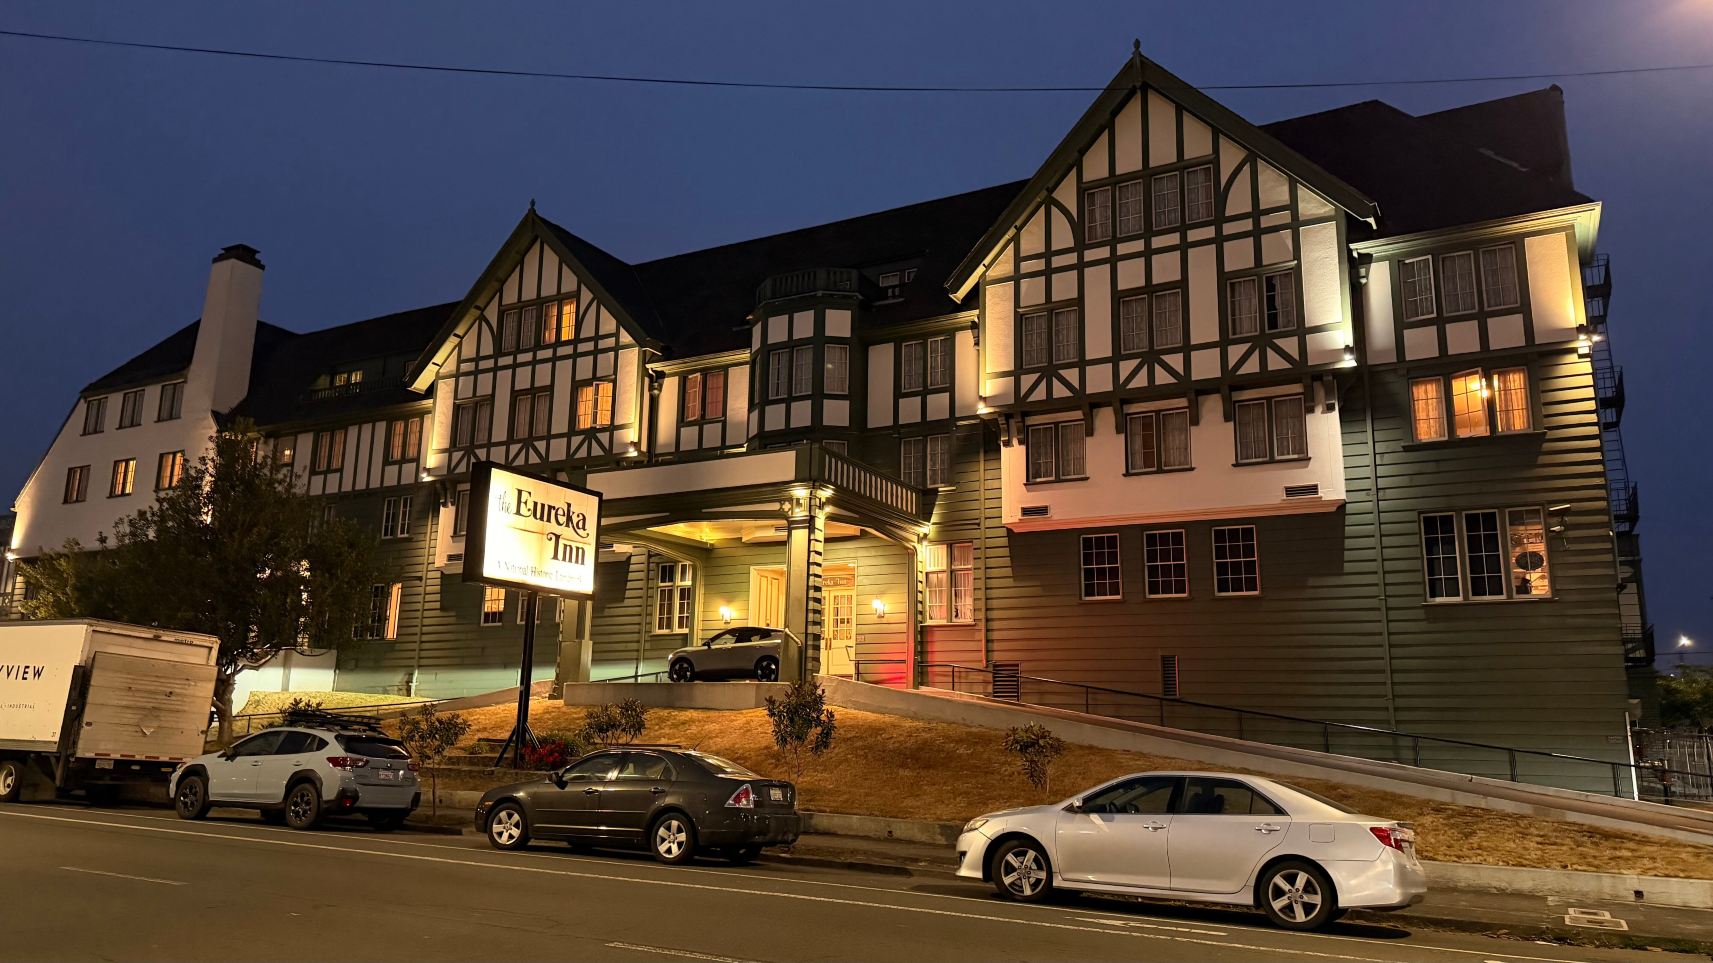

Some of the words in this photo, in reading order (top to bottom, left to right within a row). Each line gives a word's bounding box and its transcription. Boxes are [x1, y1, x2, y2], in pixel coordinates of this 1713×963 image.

[497, 490, 512, 515] the
[513, 487, 590, 539] Eureka
[546, 531, 586, 566] Inn
